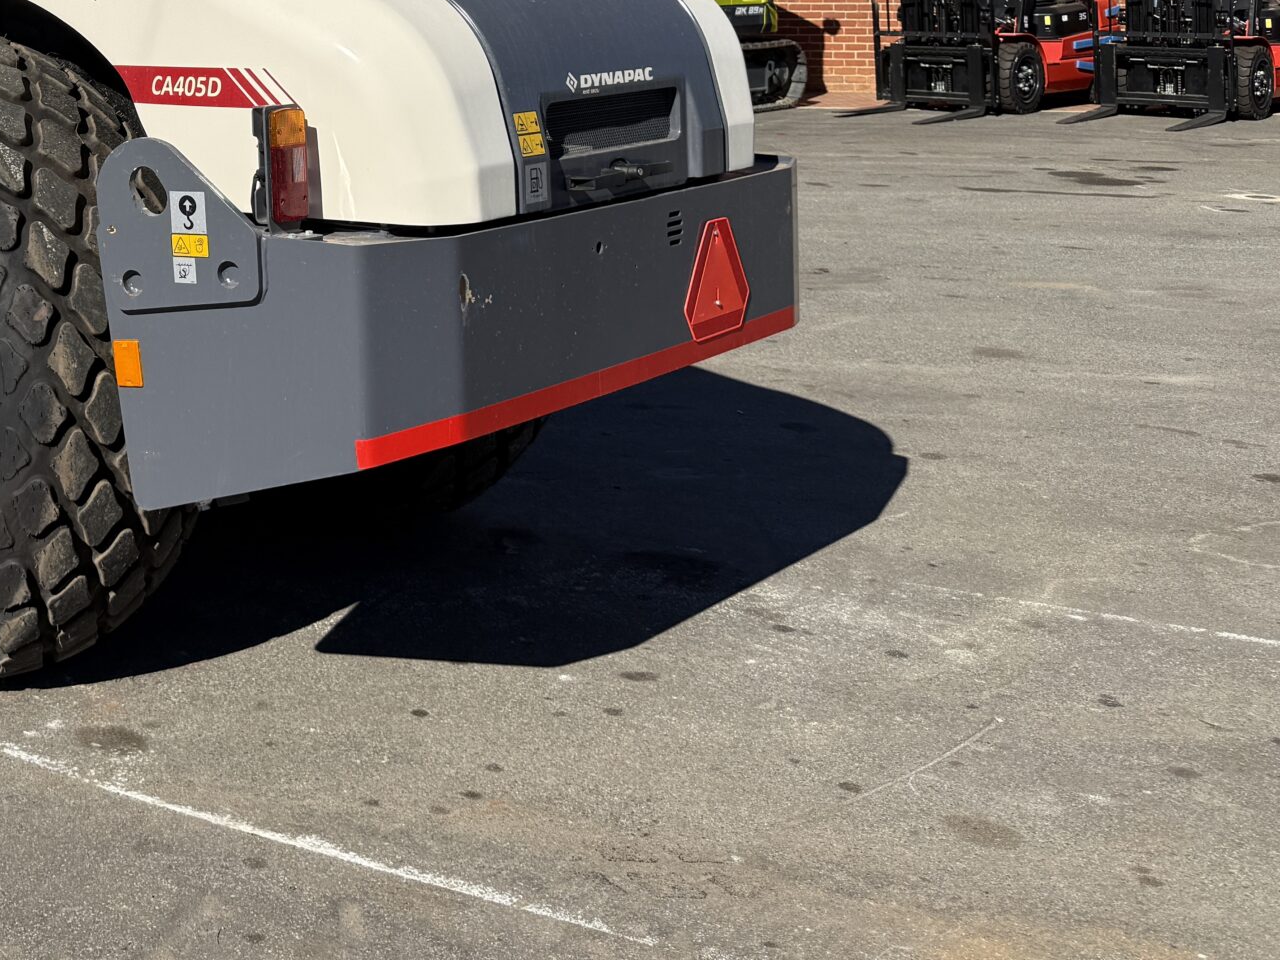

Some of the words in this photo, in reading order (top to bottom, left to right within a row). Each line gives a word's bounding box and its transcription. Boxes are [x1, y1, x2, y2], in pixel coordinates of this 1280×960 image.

[1078, 11, 1087, 21] 35
[151, 76, 221, 97] CA405D
[580, 66, 653, 88] DYNAPAC
